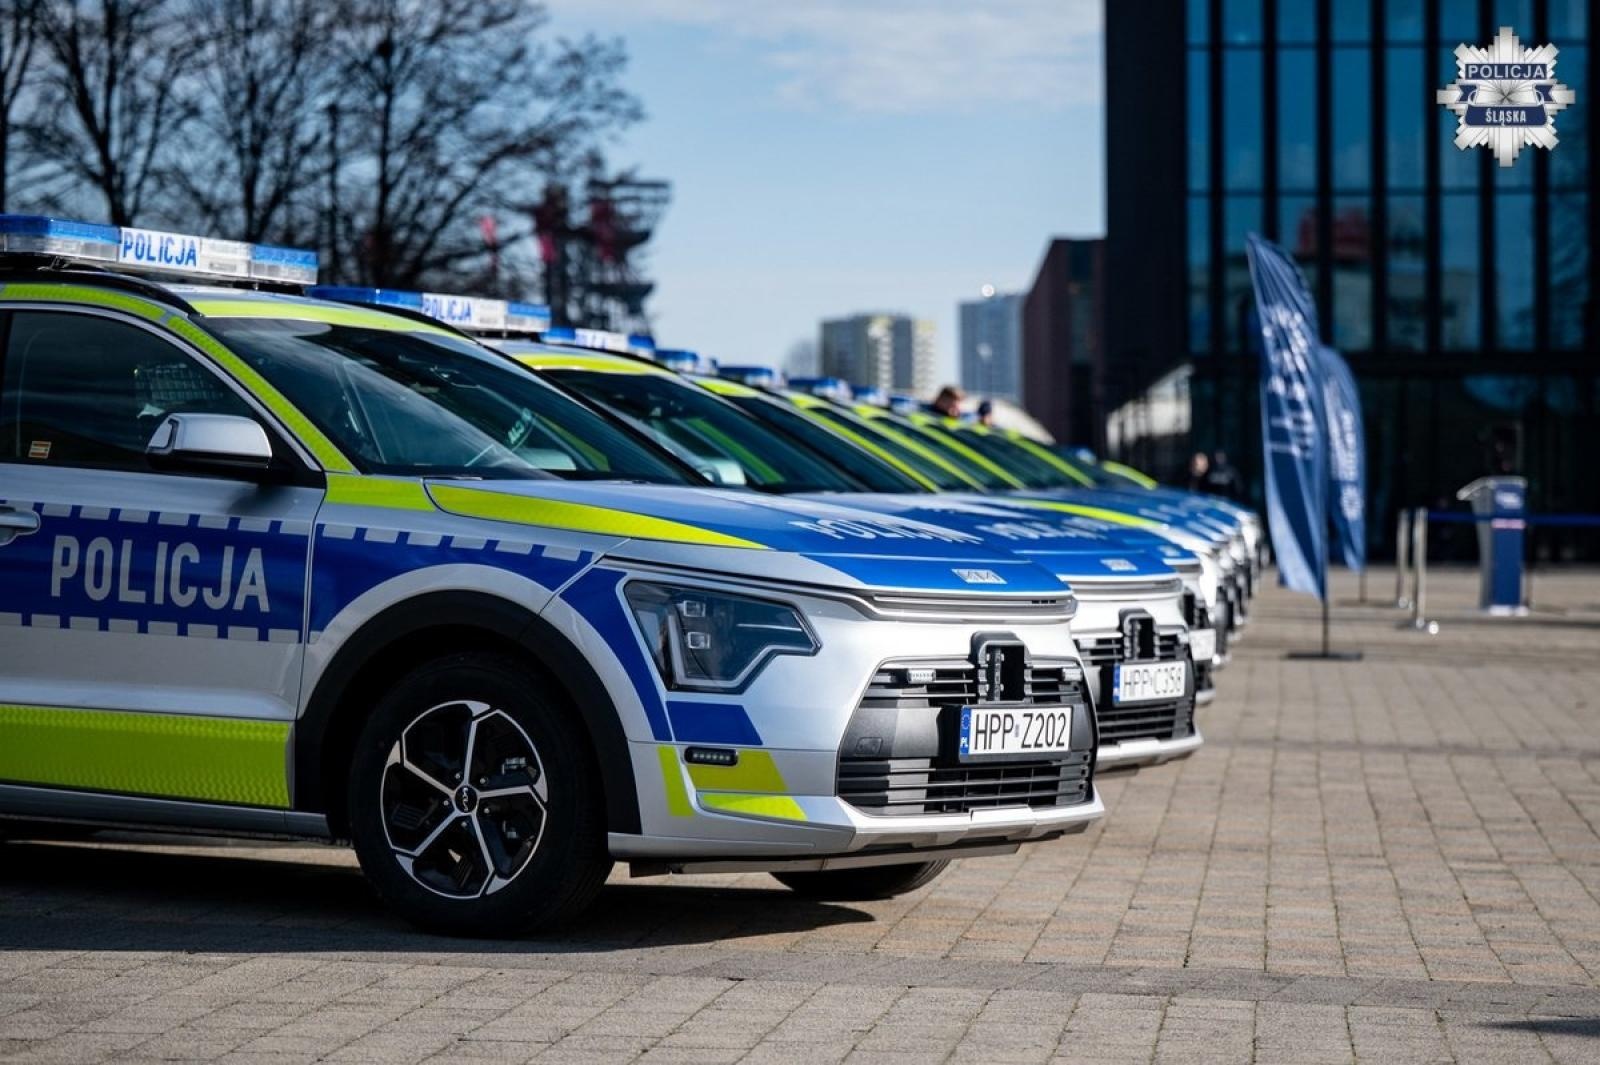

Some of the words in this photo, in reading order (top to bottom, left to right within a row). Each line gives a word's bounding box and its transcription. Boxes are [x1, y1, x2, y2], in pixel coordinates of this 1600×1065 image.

[122, 231, 198, 268] POLICJA
[50, 534, 271, 613] POLICJA
[974, 713, 1014, 750] HPP
[1021, 712, 1067, 749] Z202
